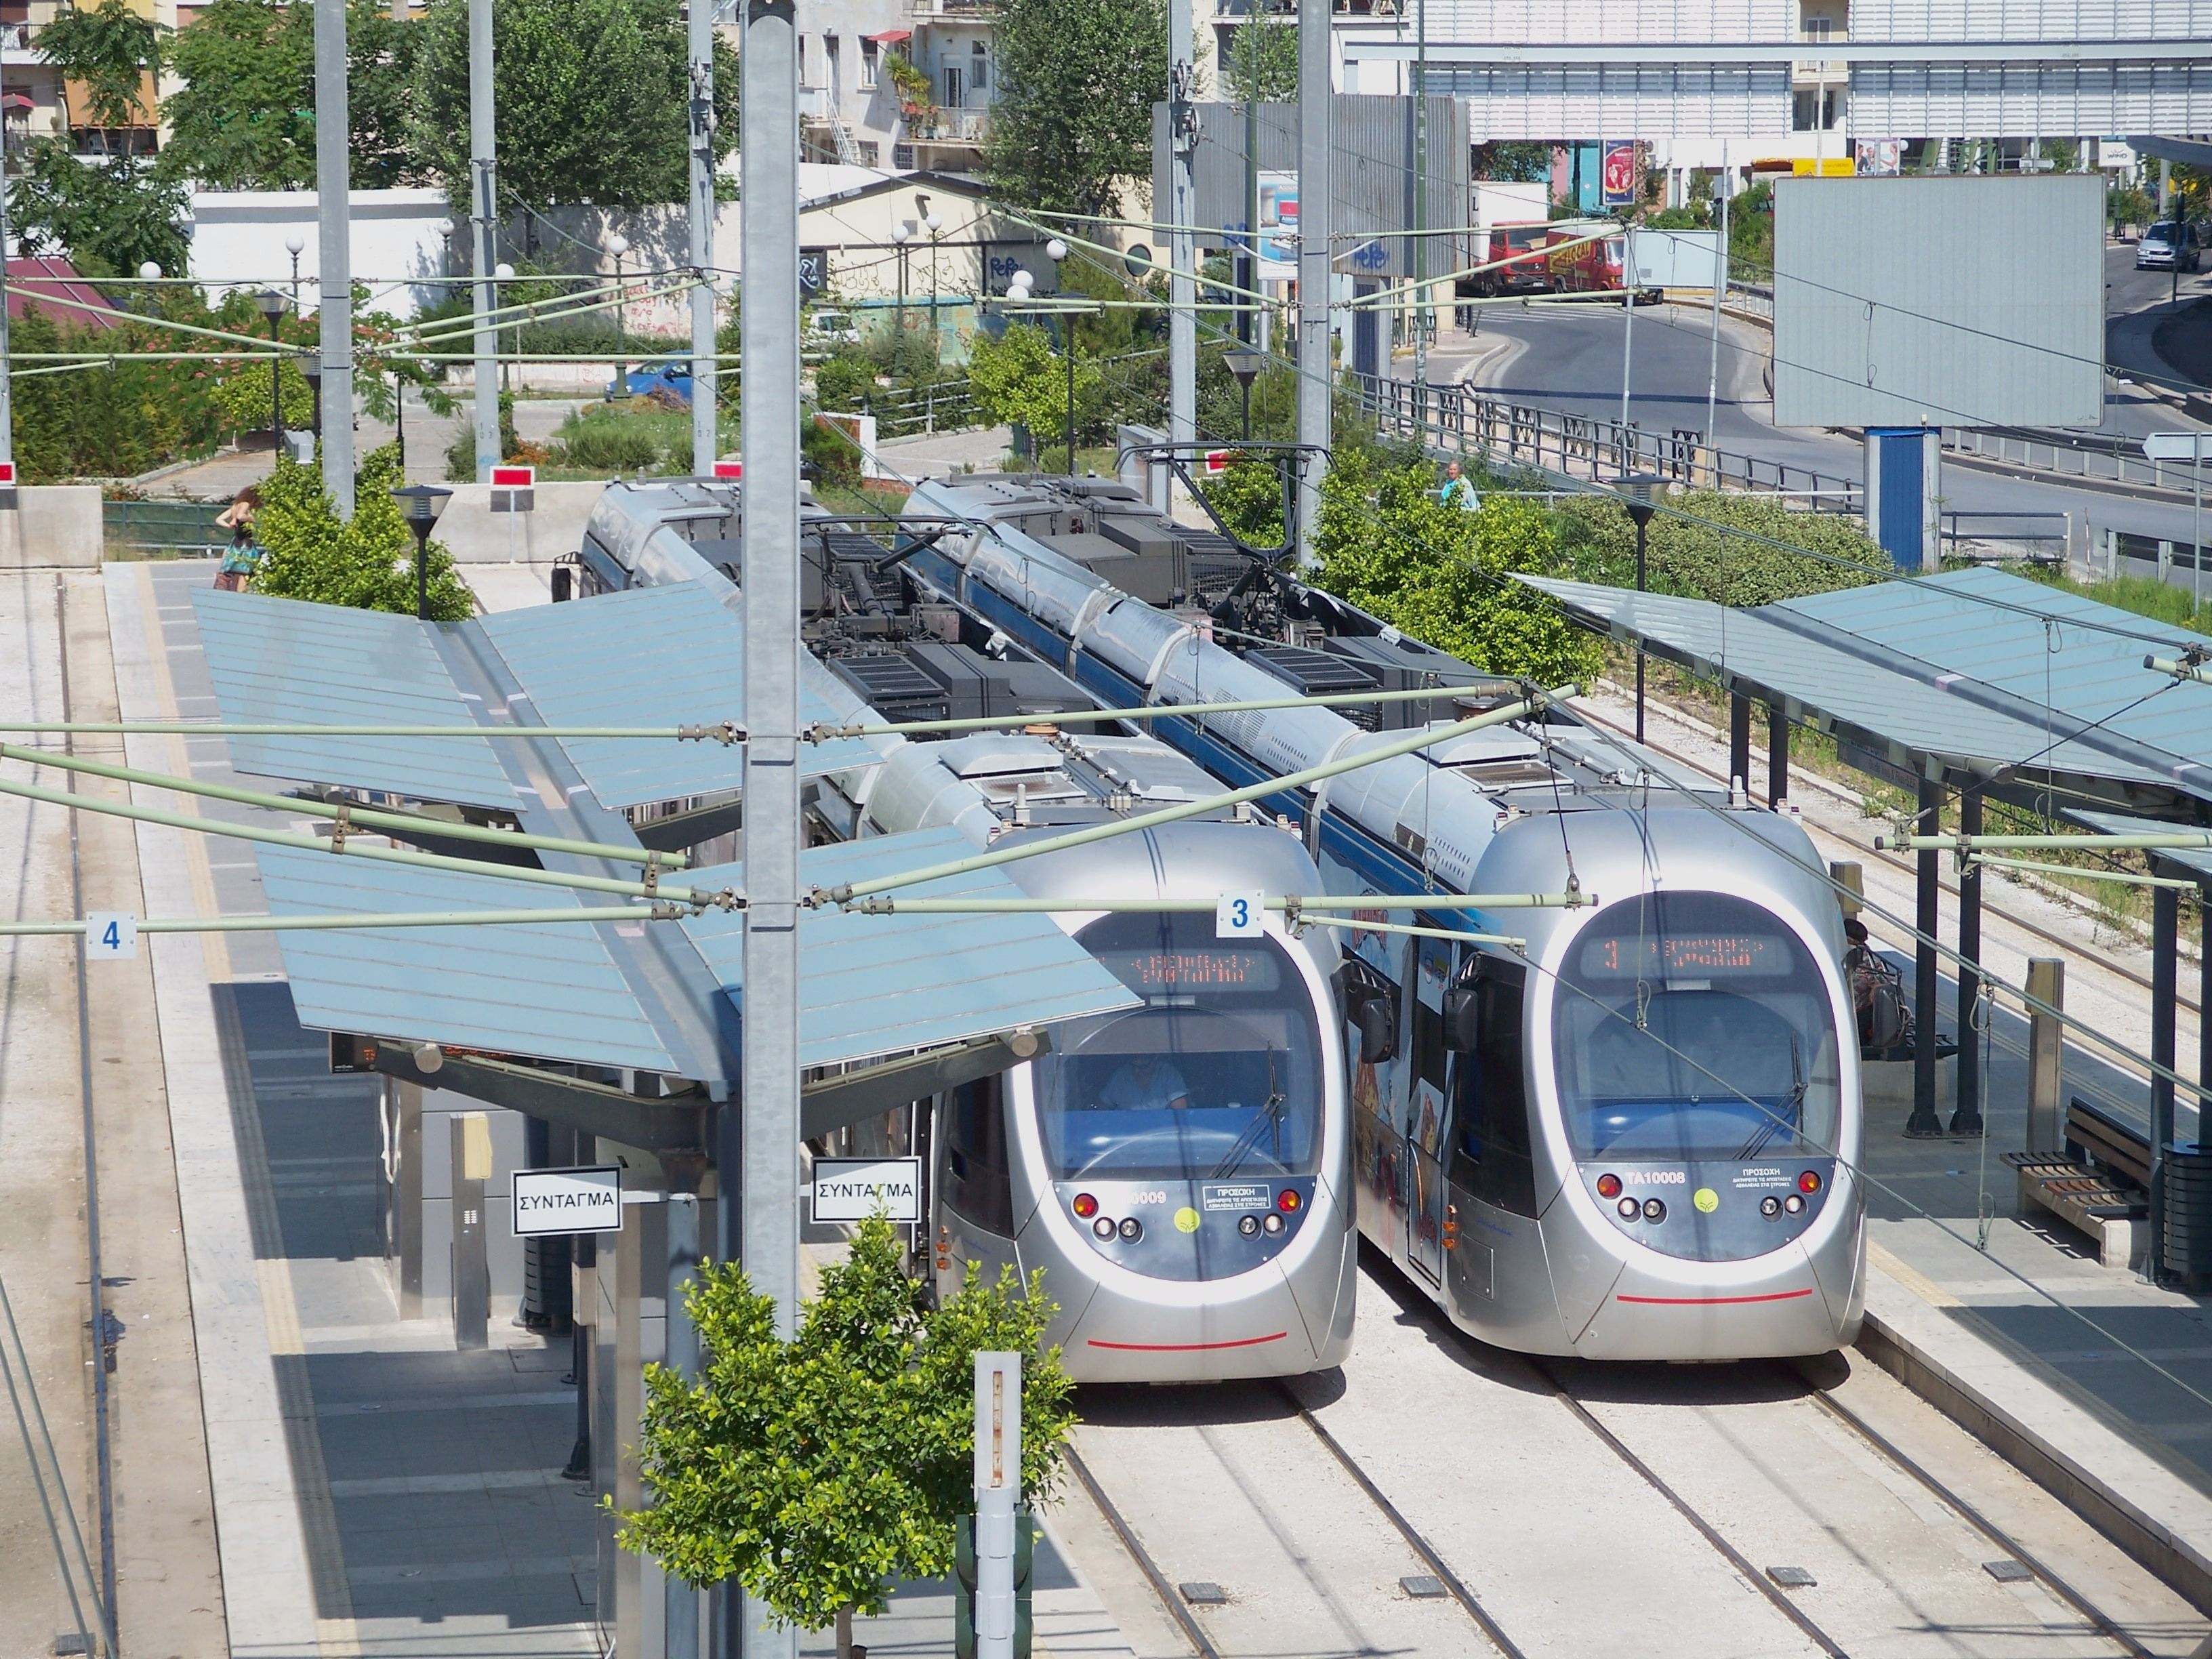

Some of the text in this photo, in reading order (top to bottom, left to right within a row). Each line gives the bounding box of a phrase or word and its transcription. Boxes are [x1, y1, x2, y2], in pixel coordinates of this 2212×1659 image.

[1232, 899, 1248, 928] 3
[102, 921, 121, 949] 4
[1742, 1168, 1780, 1176] ΠΡΟΣΟΧΗ
[520, 1192, 614, 1210] ΣΥΝΤΑΓΜΑ
[1217, 1187, 1255, 1197] ΠΡΟΣΟΧΗ
